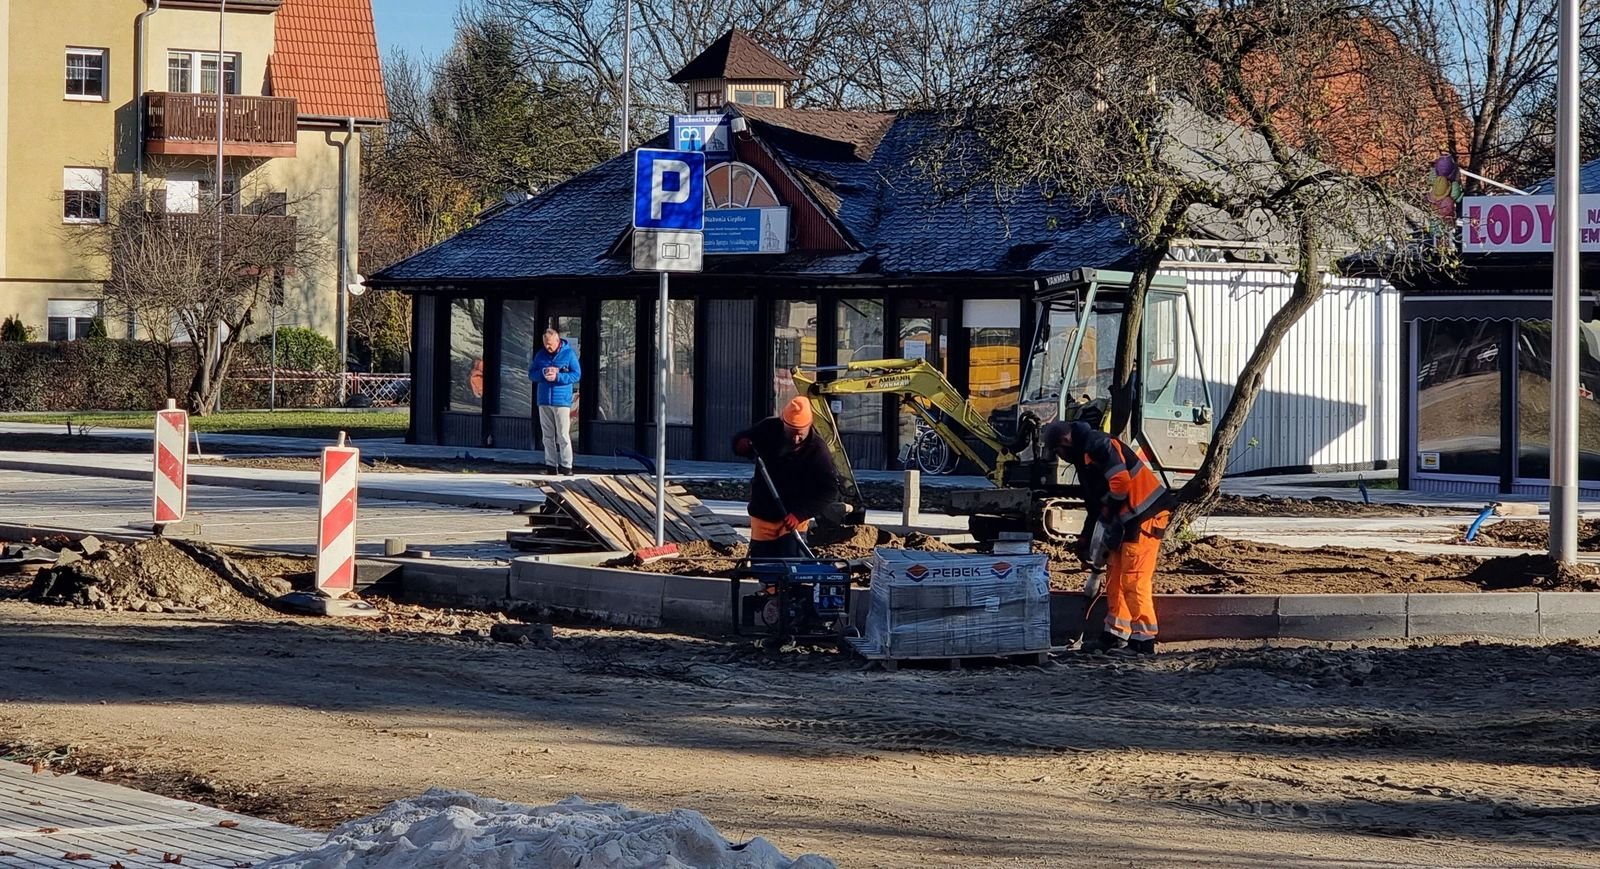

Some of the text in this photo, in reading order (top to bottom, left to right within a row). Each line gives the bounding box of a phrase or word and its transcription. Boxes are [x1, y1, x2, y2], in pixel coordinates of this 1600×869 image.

[651, 159, 690, 220] P
[1469, 203, 1556, 245] LODY
[1046, 272, 1070, 286] YANMAR
[879, 375, 910, 383] AMMANN
[932, 567, 981, 578] PEBEK
